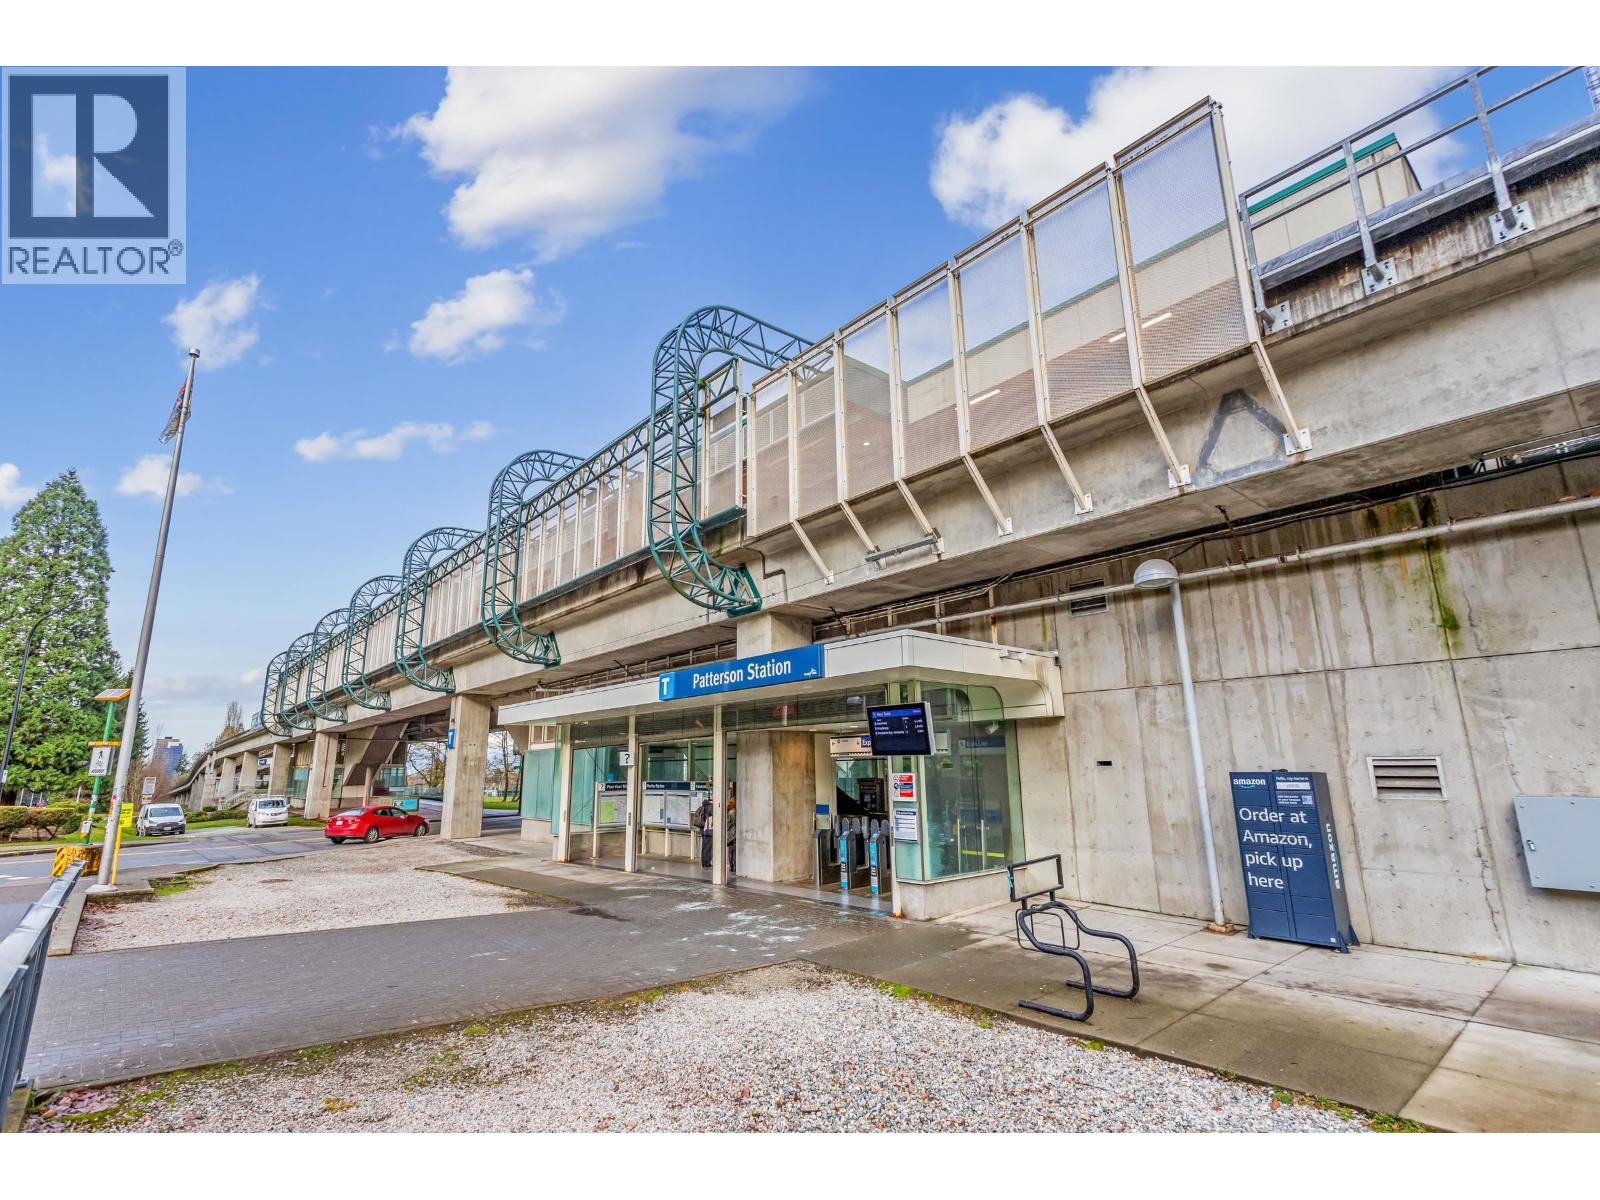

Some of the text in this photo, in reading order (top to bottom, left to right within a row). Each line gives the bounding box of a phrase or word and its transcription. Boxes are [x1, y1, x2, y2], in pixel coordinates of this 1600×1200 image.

[692, 658, 791, 689] Patterson Station
[1239, 808, 1308, 823] Order at
[1243, 830, 1313, 849] Amazon,
[1245, 852, 1303, 871] pick up
[1326, 823, 1341, 889] amazon
[1248, 872, 1284, 889] here
